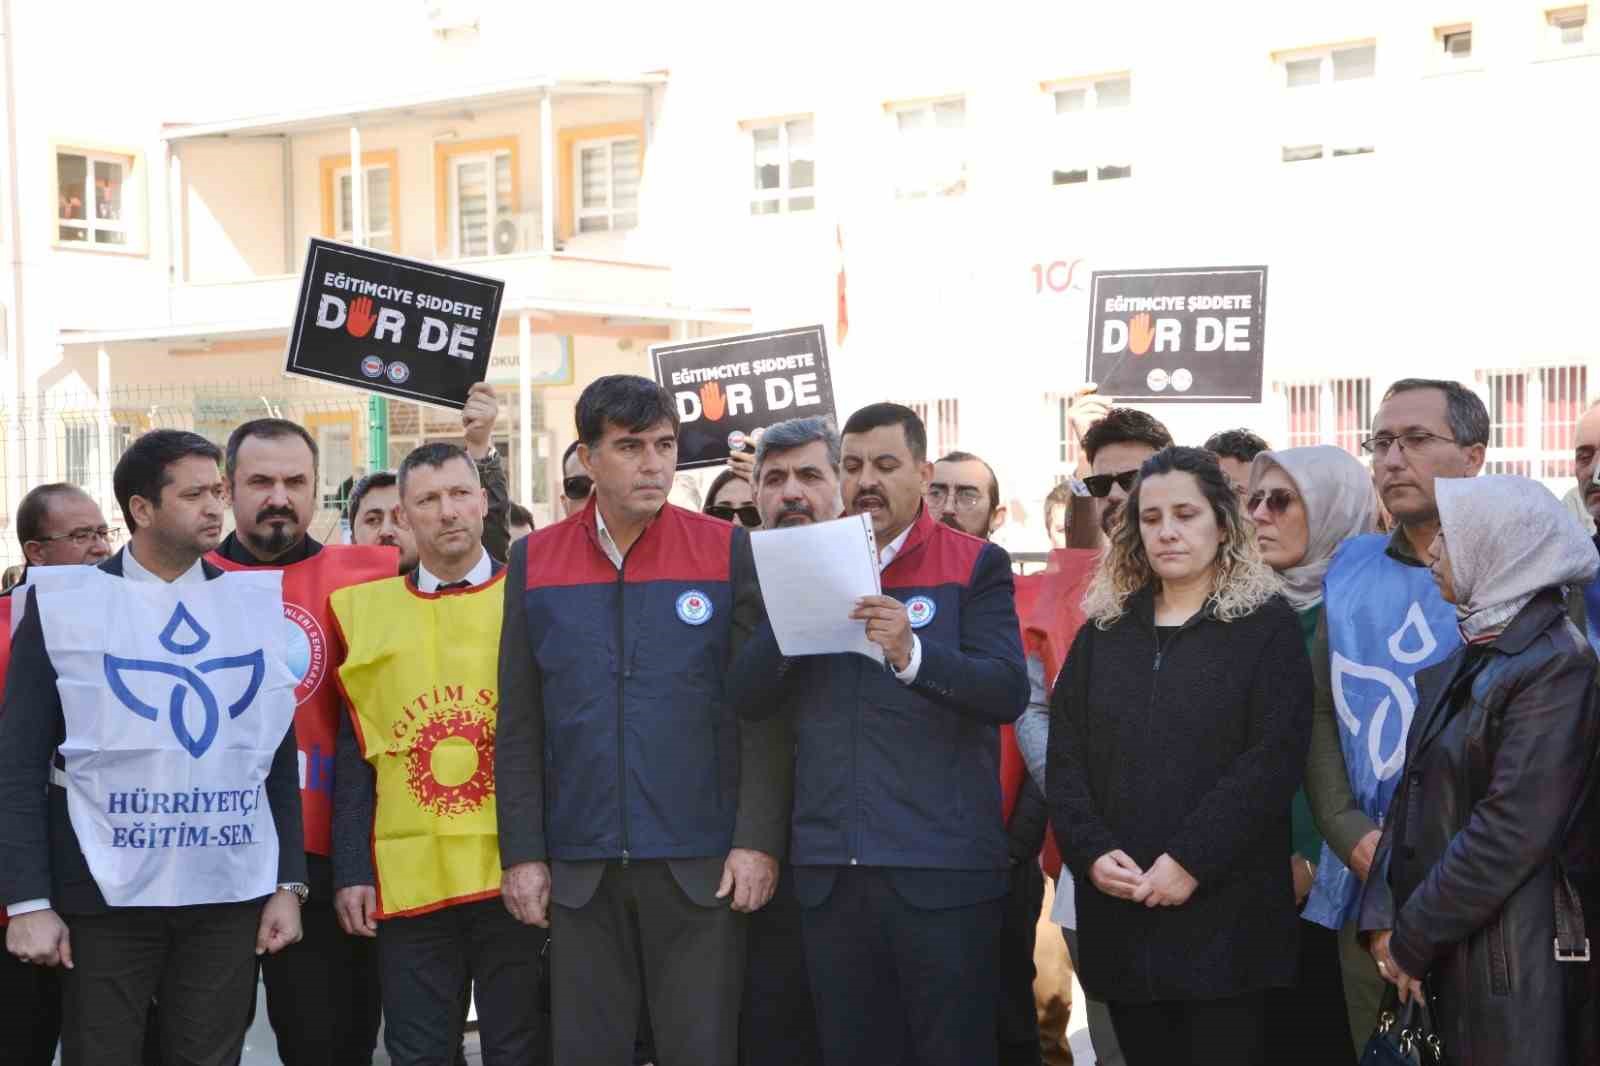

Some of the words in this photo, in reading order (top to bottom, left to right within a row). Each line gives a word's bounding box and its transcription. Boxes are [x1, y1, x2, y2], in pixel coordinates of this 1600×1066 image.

[323, 271, 414, 305] EĞİTİMCİYE
[415, 294, 483, 320] ŞİDDETE
[417, 315, 479, 361] DE
[1194, 316, 1251, 352] DE
[764, 372, 821, 410] DE
[108, 784, 262, 815] HÜRRİYETÇİ
[111, 823, 255, 849] EĞİTİM-SEN
